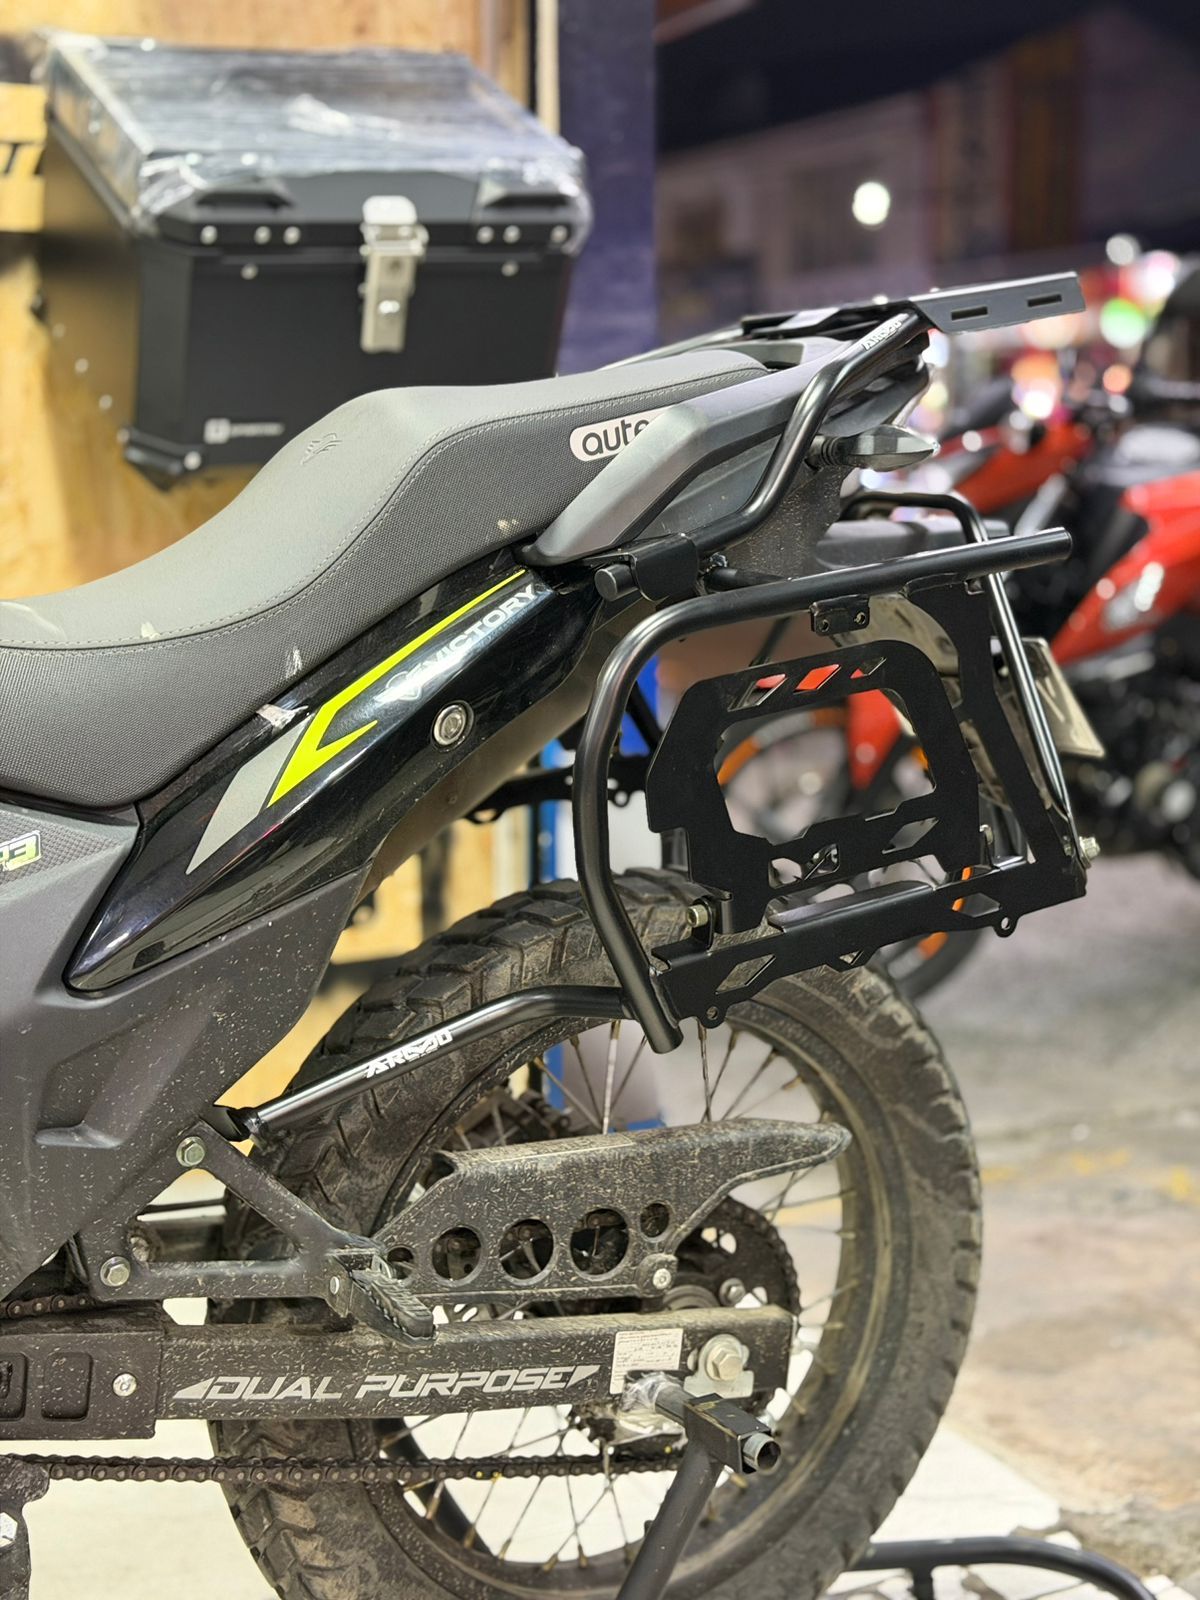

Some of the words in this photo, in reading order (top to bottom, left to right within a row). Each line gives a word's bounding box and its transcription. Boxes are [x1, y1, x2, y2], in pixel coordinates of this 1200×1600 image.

[421, 583, 538, 668] VICTORY
[205, 1375, 343, 1400] DUAL
[354, 1365, 576, 1400] PURPOSE
